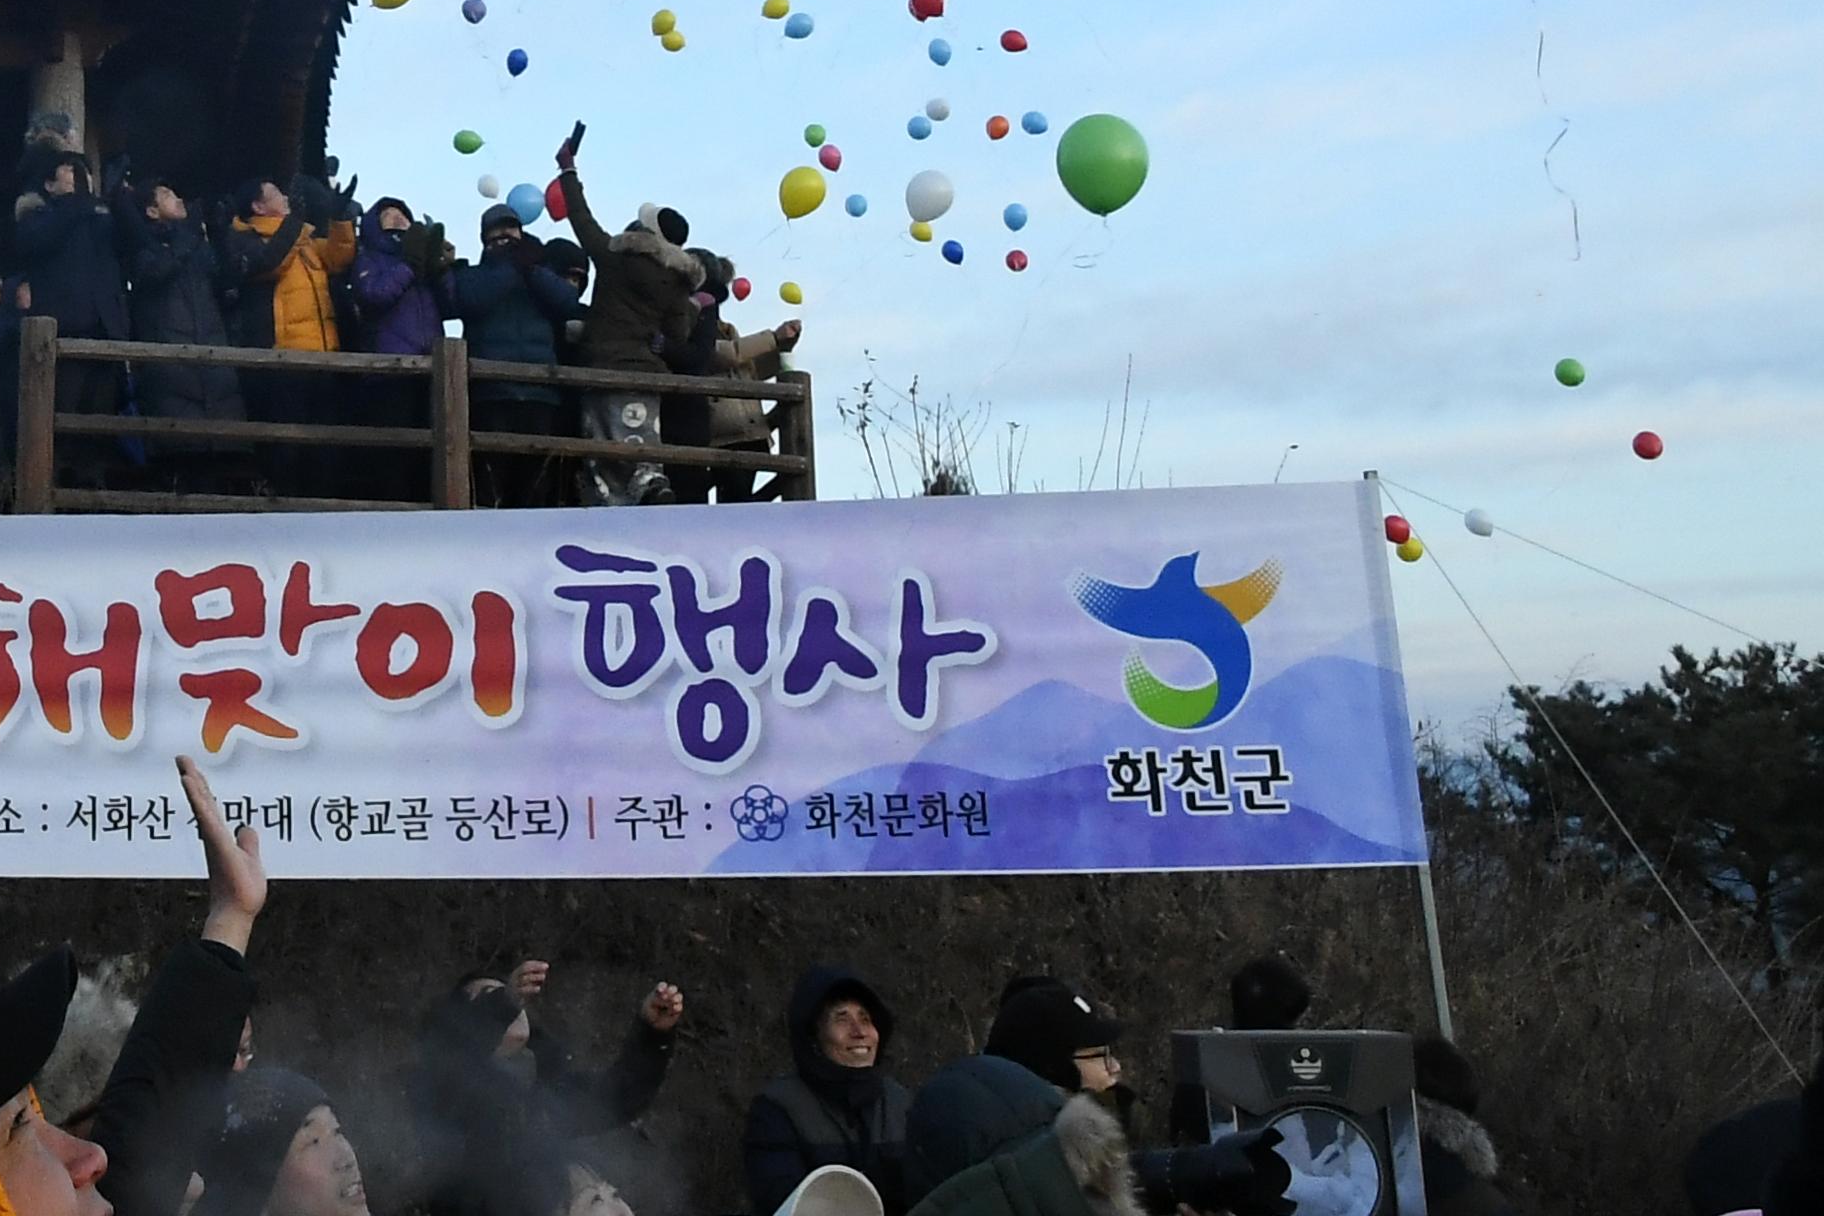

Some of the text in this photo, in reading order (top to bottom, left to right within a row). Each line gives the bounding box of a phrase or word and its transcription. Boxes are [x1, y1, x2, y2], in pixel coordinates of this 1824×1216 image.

[554, 544, 986, 762] 행사
[1106, 746, 1291, 815] 화천군
[66, 794, 176, 842] 서화산
[186, 794, 292, 842] 망대
[310, 794, 434, 842] (향교골
[445, 794, 570, 842] 등산로)
[805, 790, 992, 840] 화천문화원
